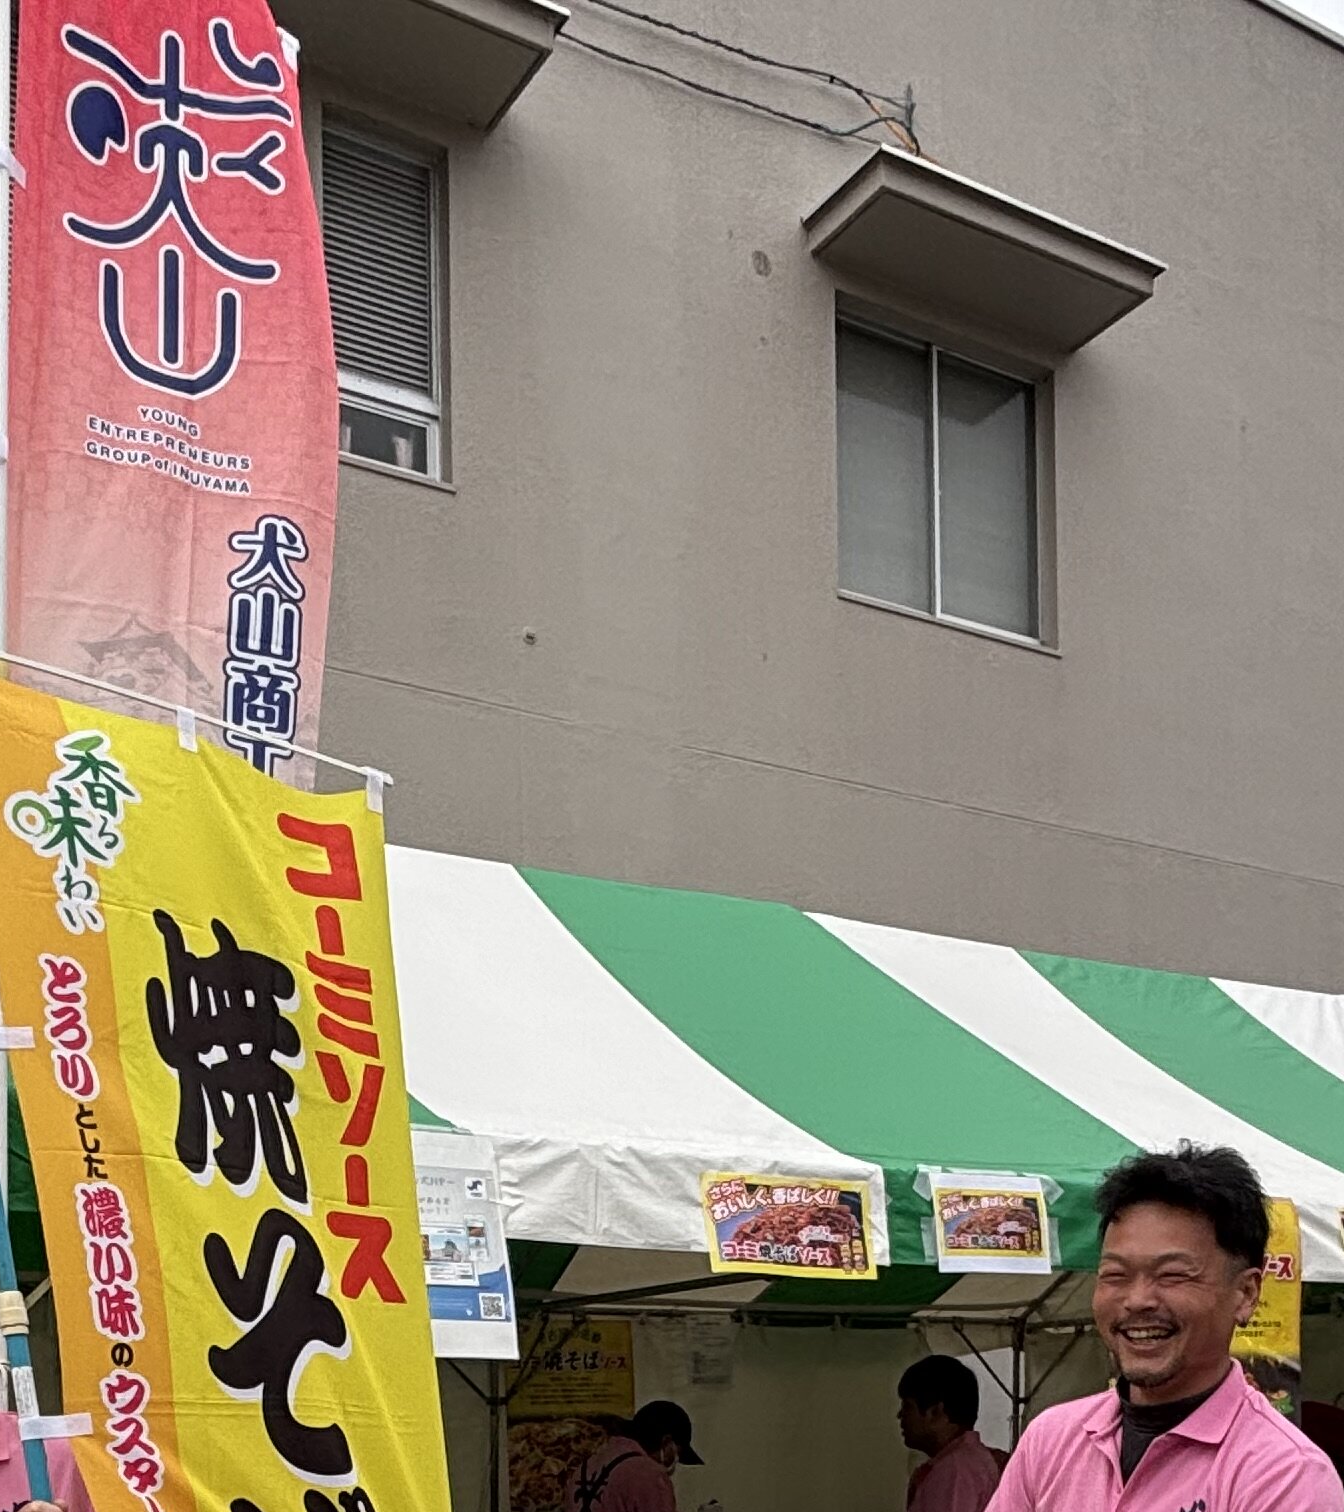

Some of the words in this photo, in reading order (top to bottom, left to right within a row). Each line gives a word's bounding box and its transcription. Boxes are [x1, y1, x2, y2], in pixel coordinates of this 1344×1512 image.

[88, 417, 251, 471] ENTREPRENEURS
[139, 406, 200, 437] YOUNG
[85, 442, 152, 465] GROUP
[154, 459, 169, 473] of
[169, 463, 251, 495] INUYAMA
[277, 812, 407, 1304] コーミソース
